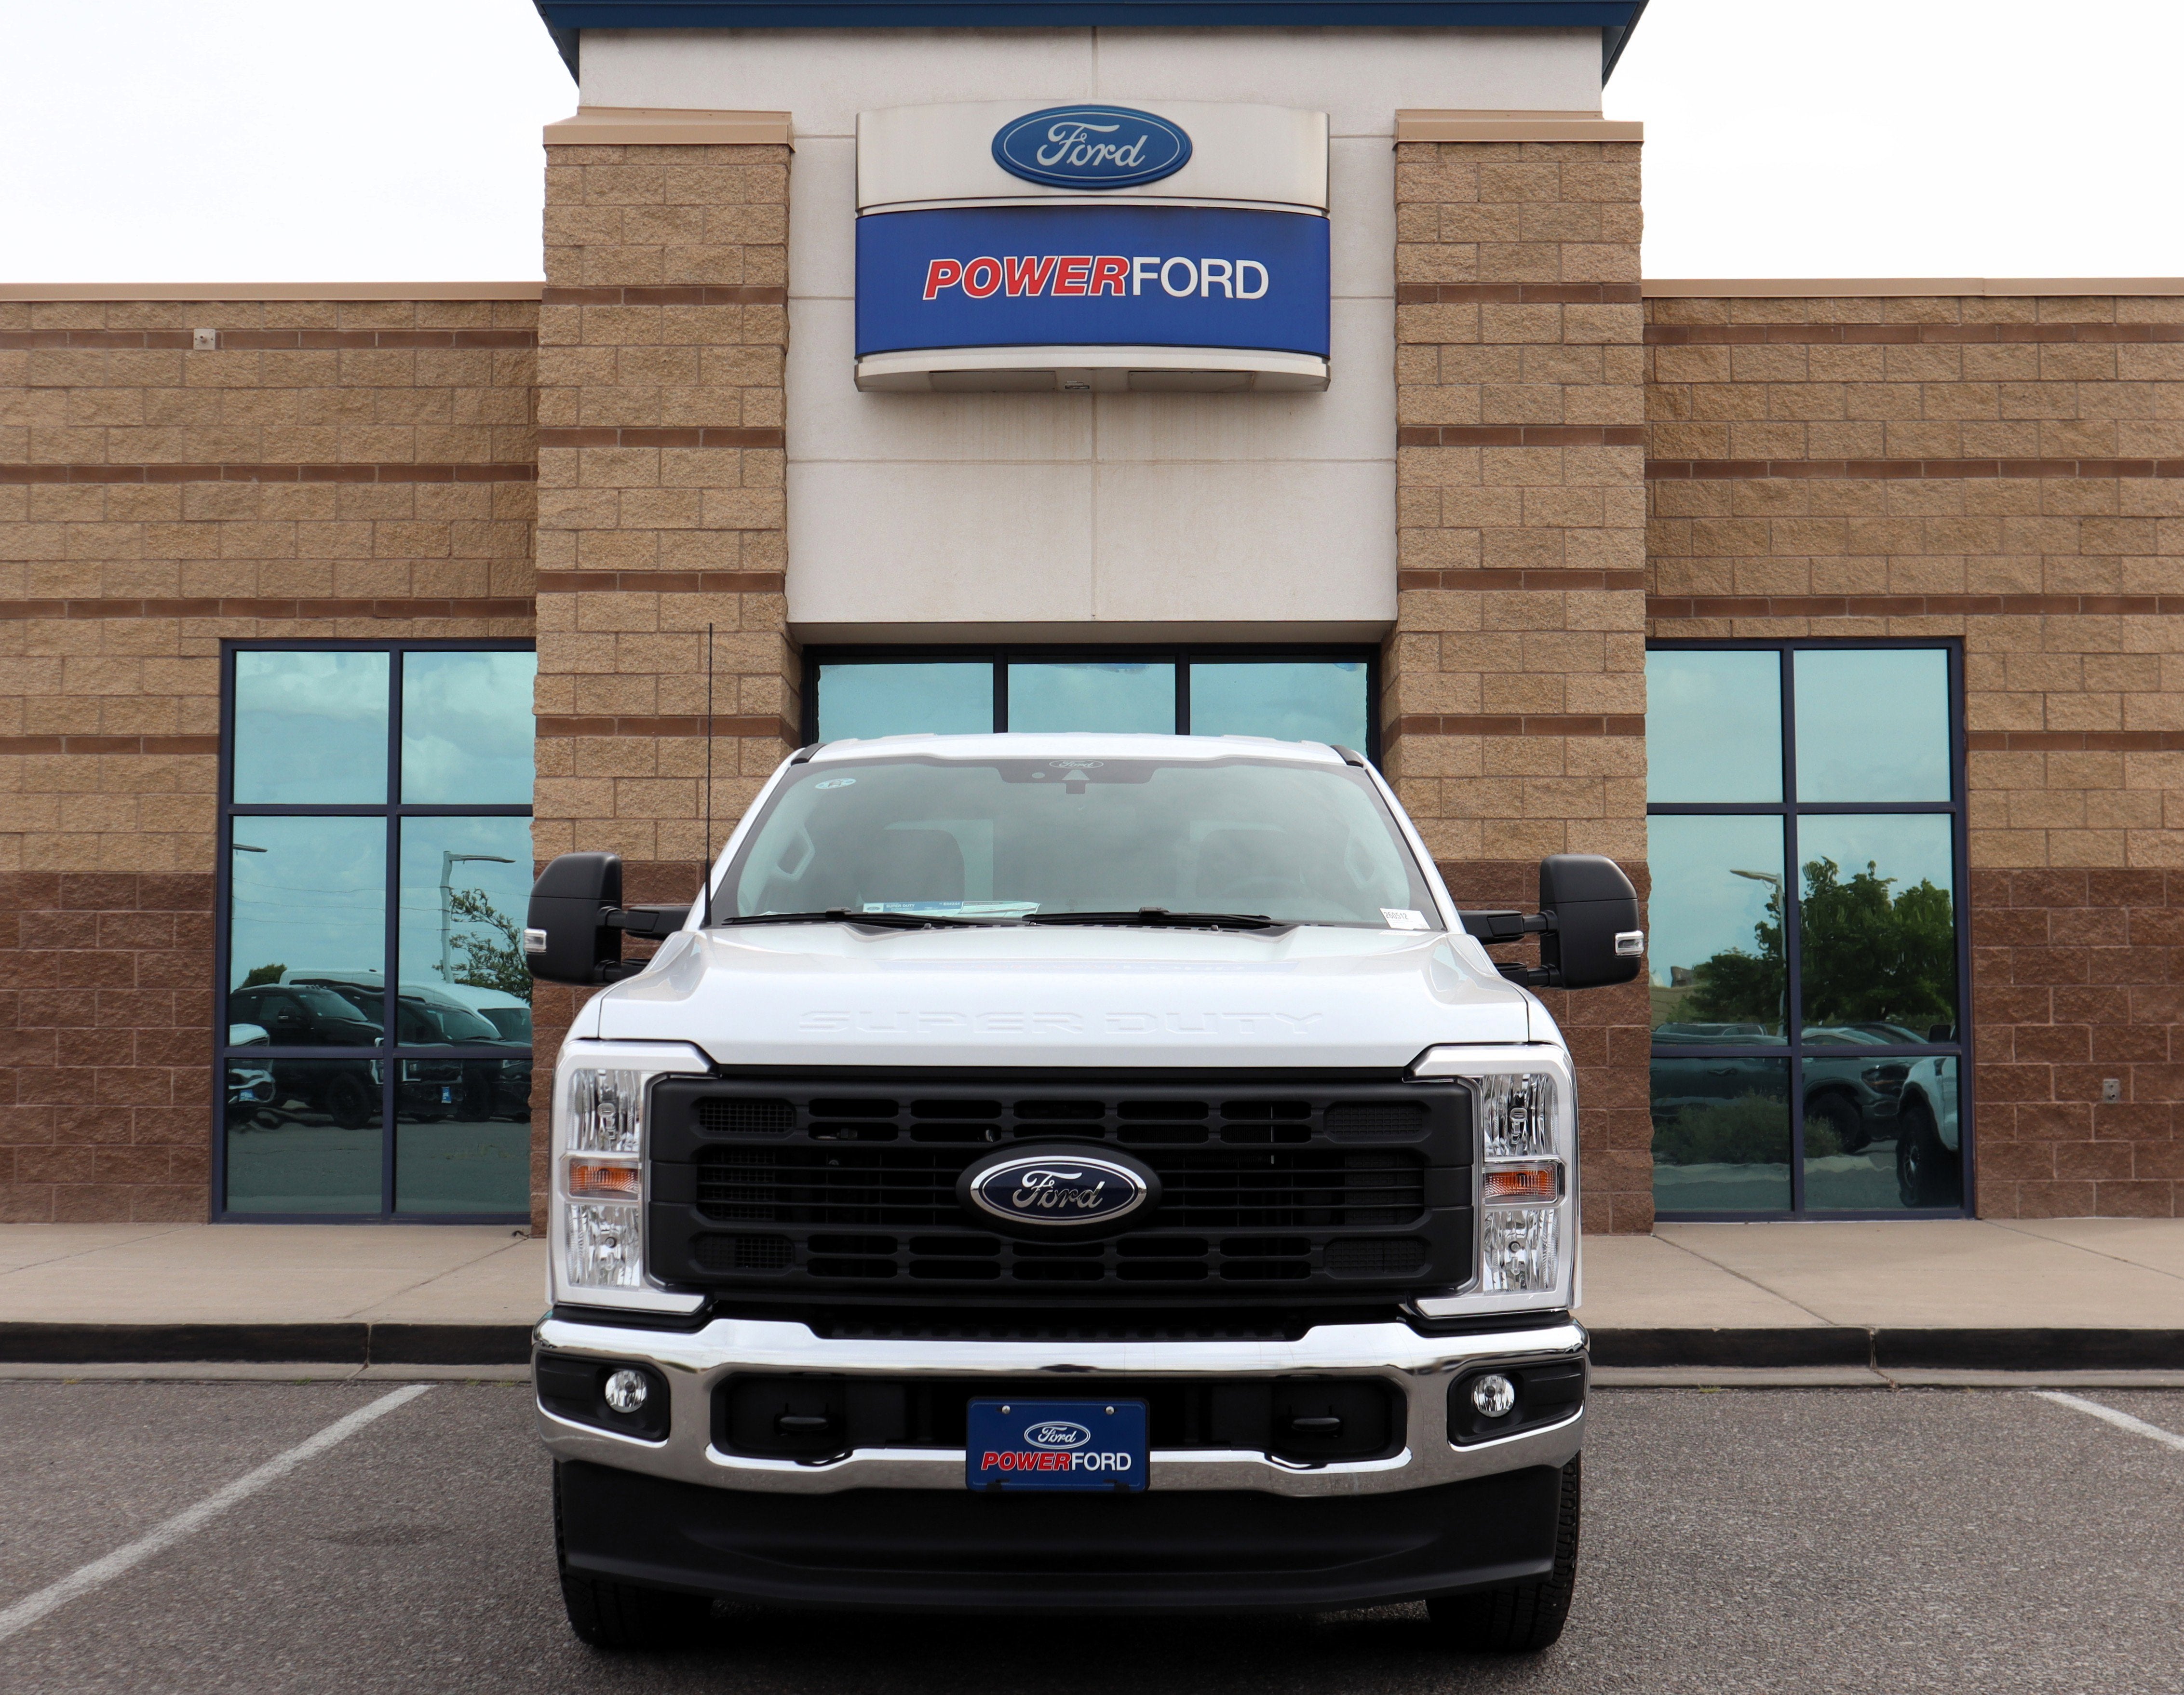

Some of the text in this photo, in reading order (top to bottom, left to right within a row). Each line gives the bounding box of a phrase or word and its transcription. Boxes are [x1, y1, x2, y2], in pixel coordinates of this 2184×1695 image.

[1036, 121, 1148, 167] Ford
[799, 1010, 1323, 1034] SUPER DUTY
[1012, 1170, 1105, 1208] Ford
[1038, 1426, 1077, 1443] Ford
